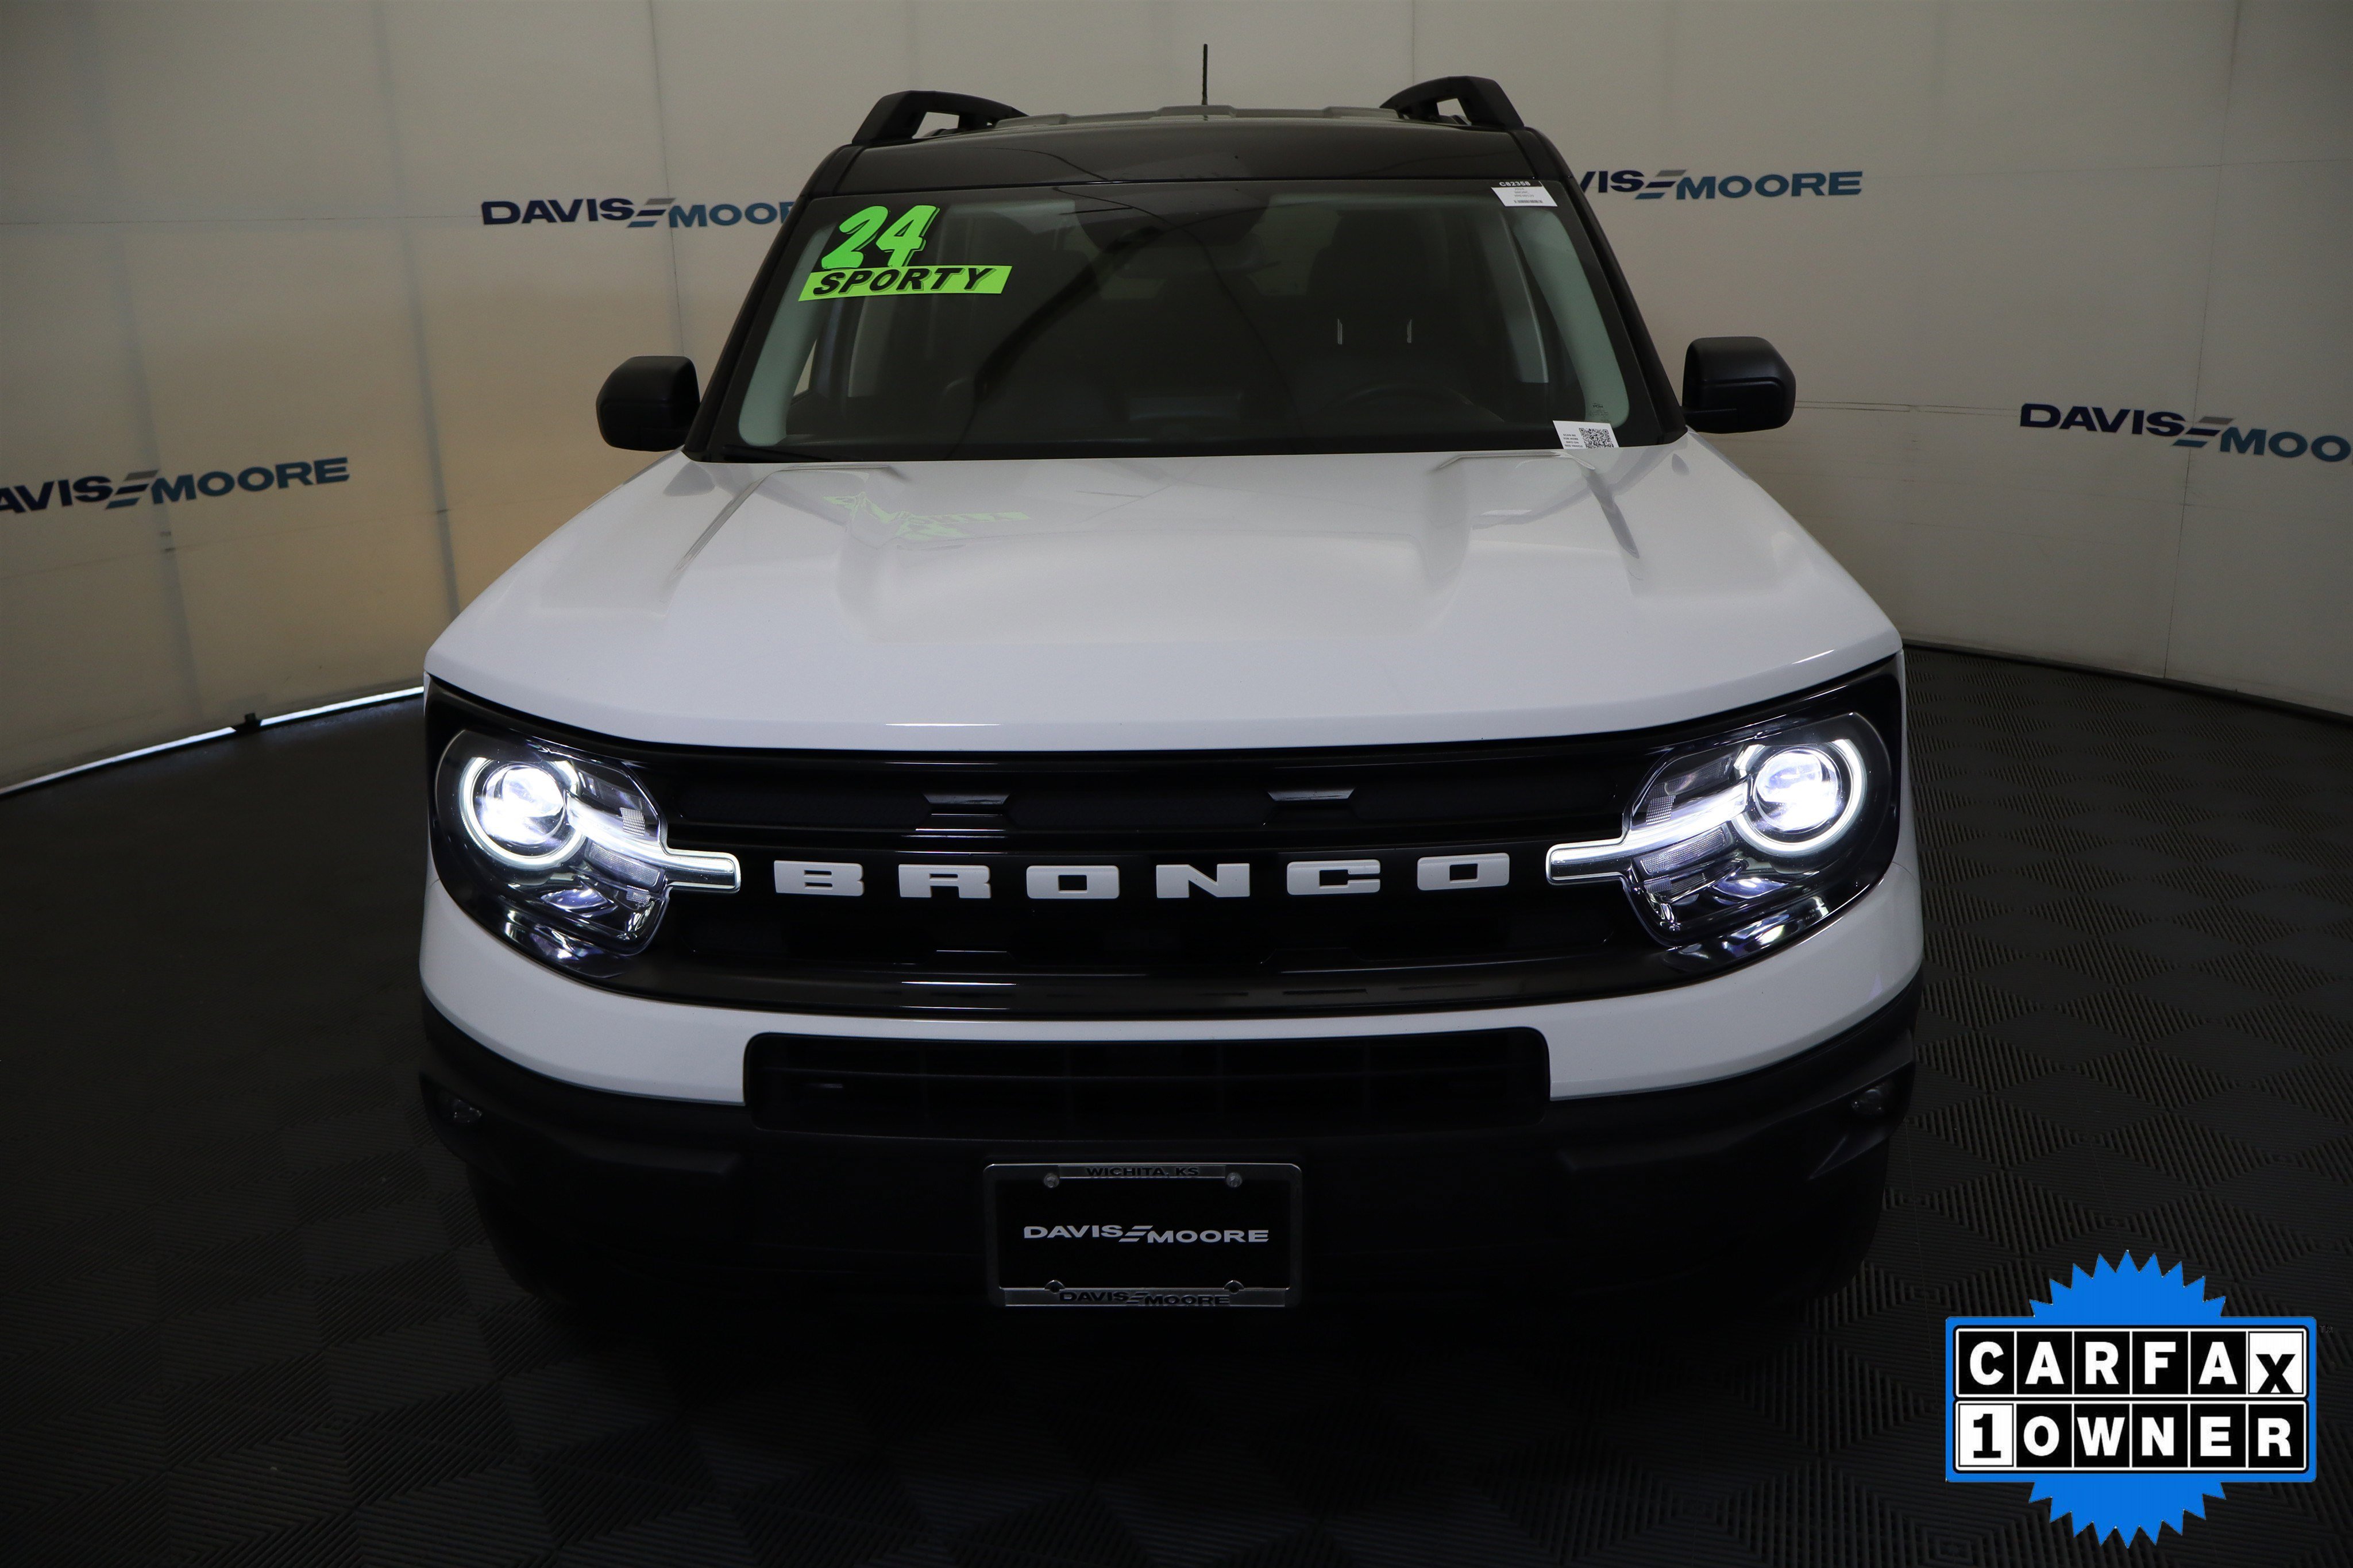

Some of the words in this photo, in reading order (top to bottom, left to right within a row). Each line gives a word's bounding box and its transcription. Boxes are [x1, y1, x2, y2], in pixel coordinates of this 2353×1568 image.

[1676, 171, 1863, 200] MOORE
[481, 198, 635, 225] DAVIS
[821, 204, 940, 269] 24
[813, 267, 997, 296] SPORTY
[2020, 403, 2186, 437] DAVIS
[2220, 426, 2353, 462] MOO
[151, 457, 350, 505] MOORE
[774, 852, 1510, 899] BRONCO
[1175, 1167, 1199, 1176] KS
[1024, 1225, 1123, 1239] DAVIS
[1147, 1230, 1269, 1243] MOORE
[1059, 1292, 1128, 1302] DAVIS
[1145, 1295, 1230, 1306] MOORE
